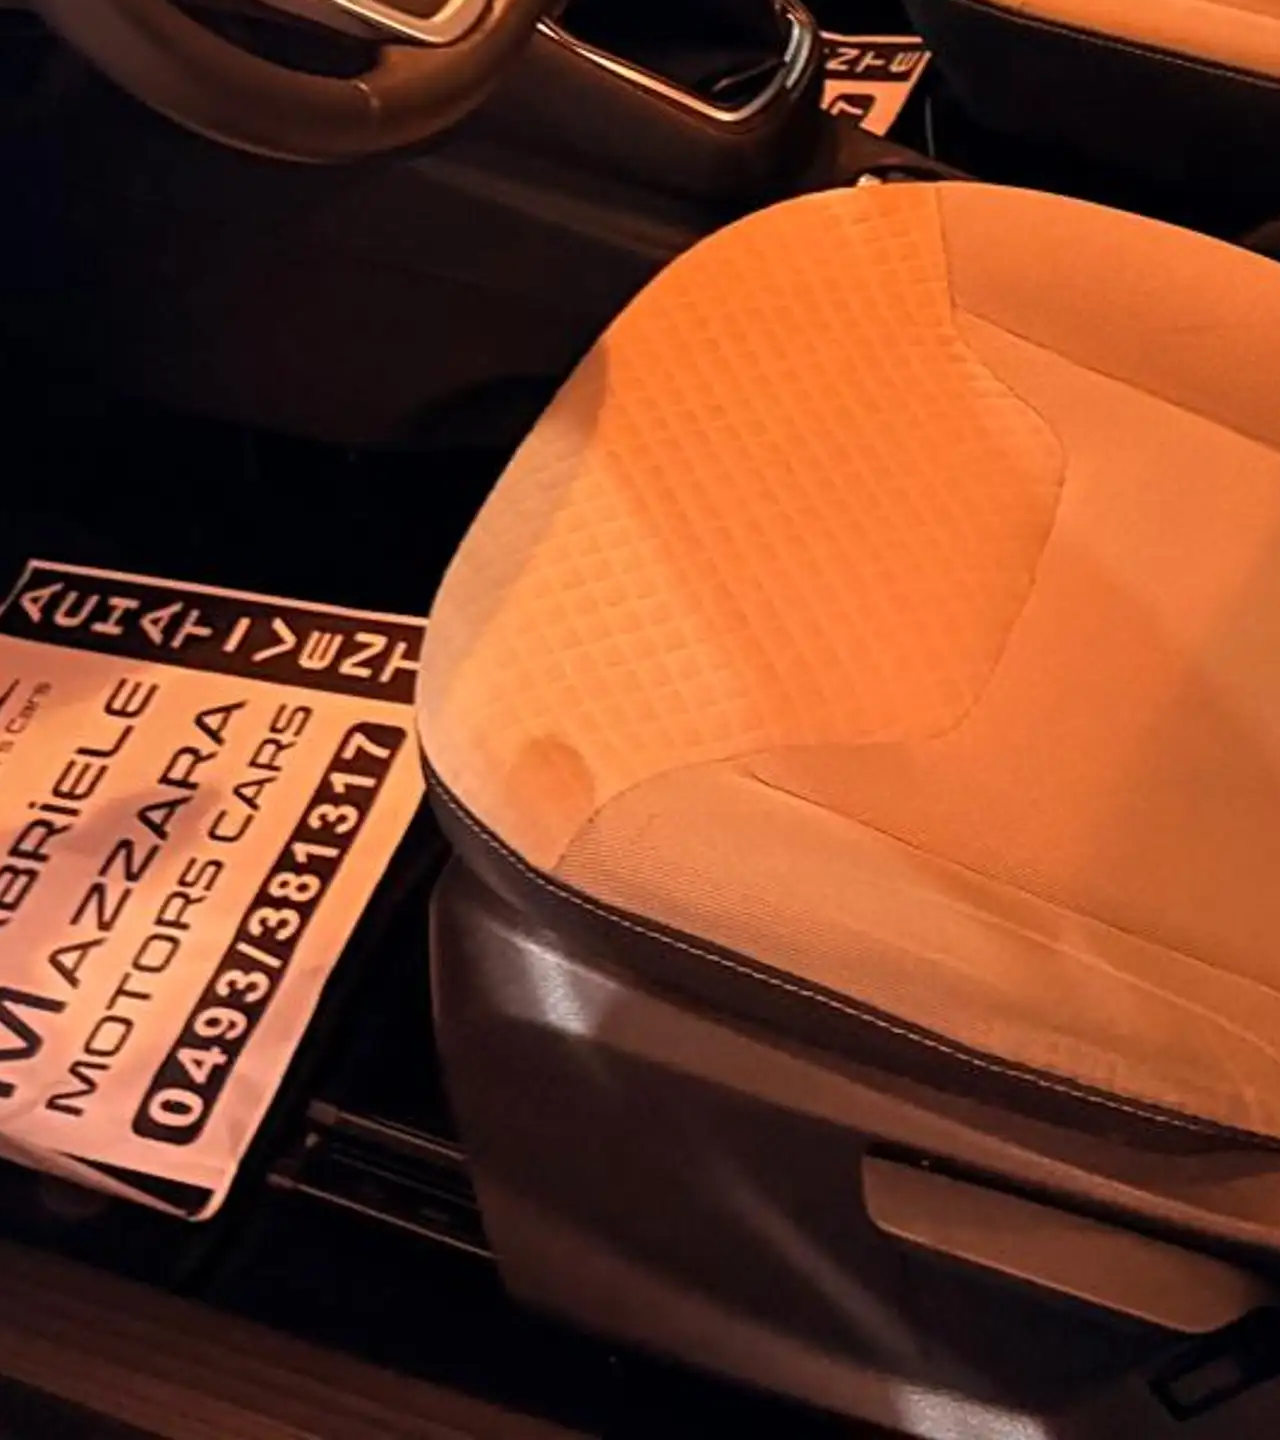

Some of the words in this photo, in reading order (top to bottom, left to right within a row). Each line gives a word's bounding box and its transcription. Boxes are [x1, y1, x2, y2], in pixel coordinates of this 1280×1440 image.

[823, 47, 921, 74] NTE
[5, 680, 52, 734] Cars
[44, 858, 223, 1117] MOTORS
[207, 703, 313, 844] CARS
[146, 732, 393, 1128] 0493/381317
